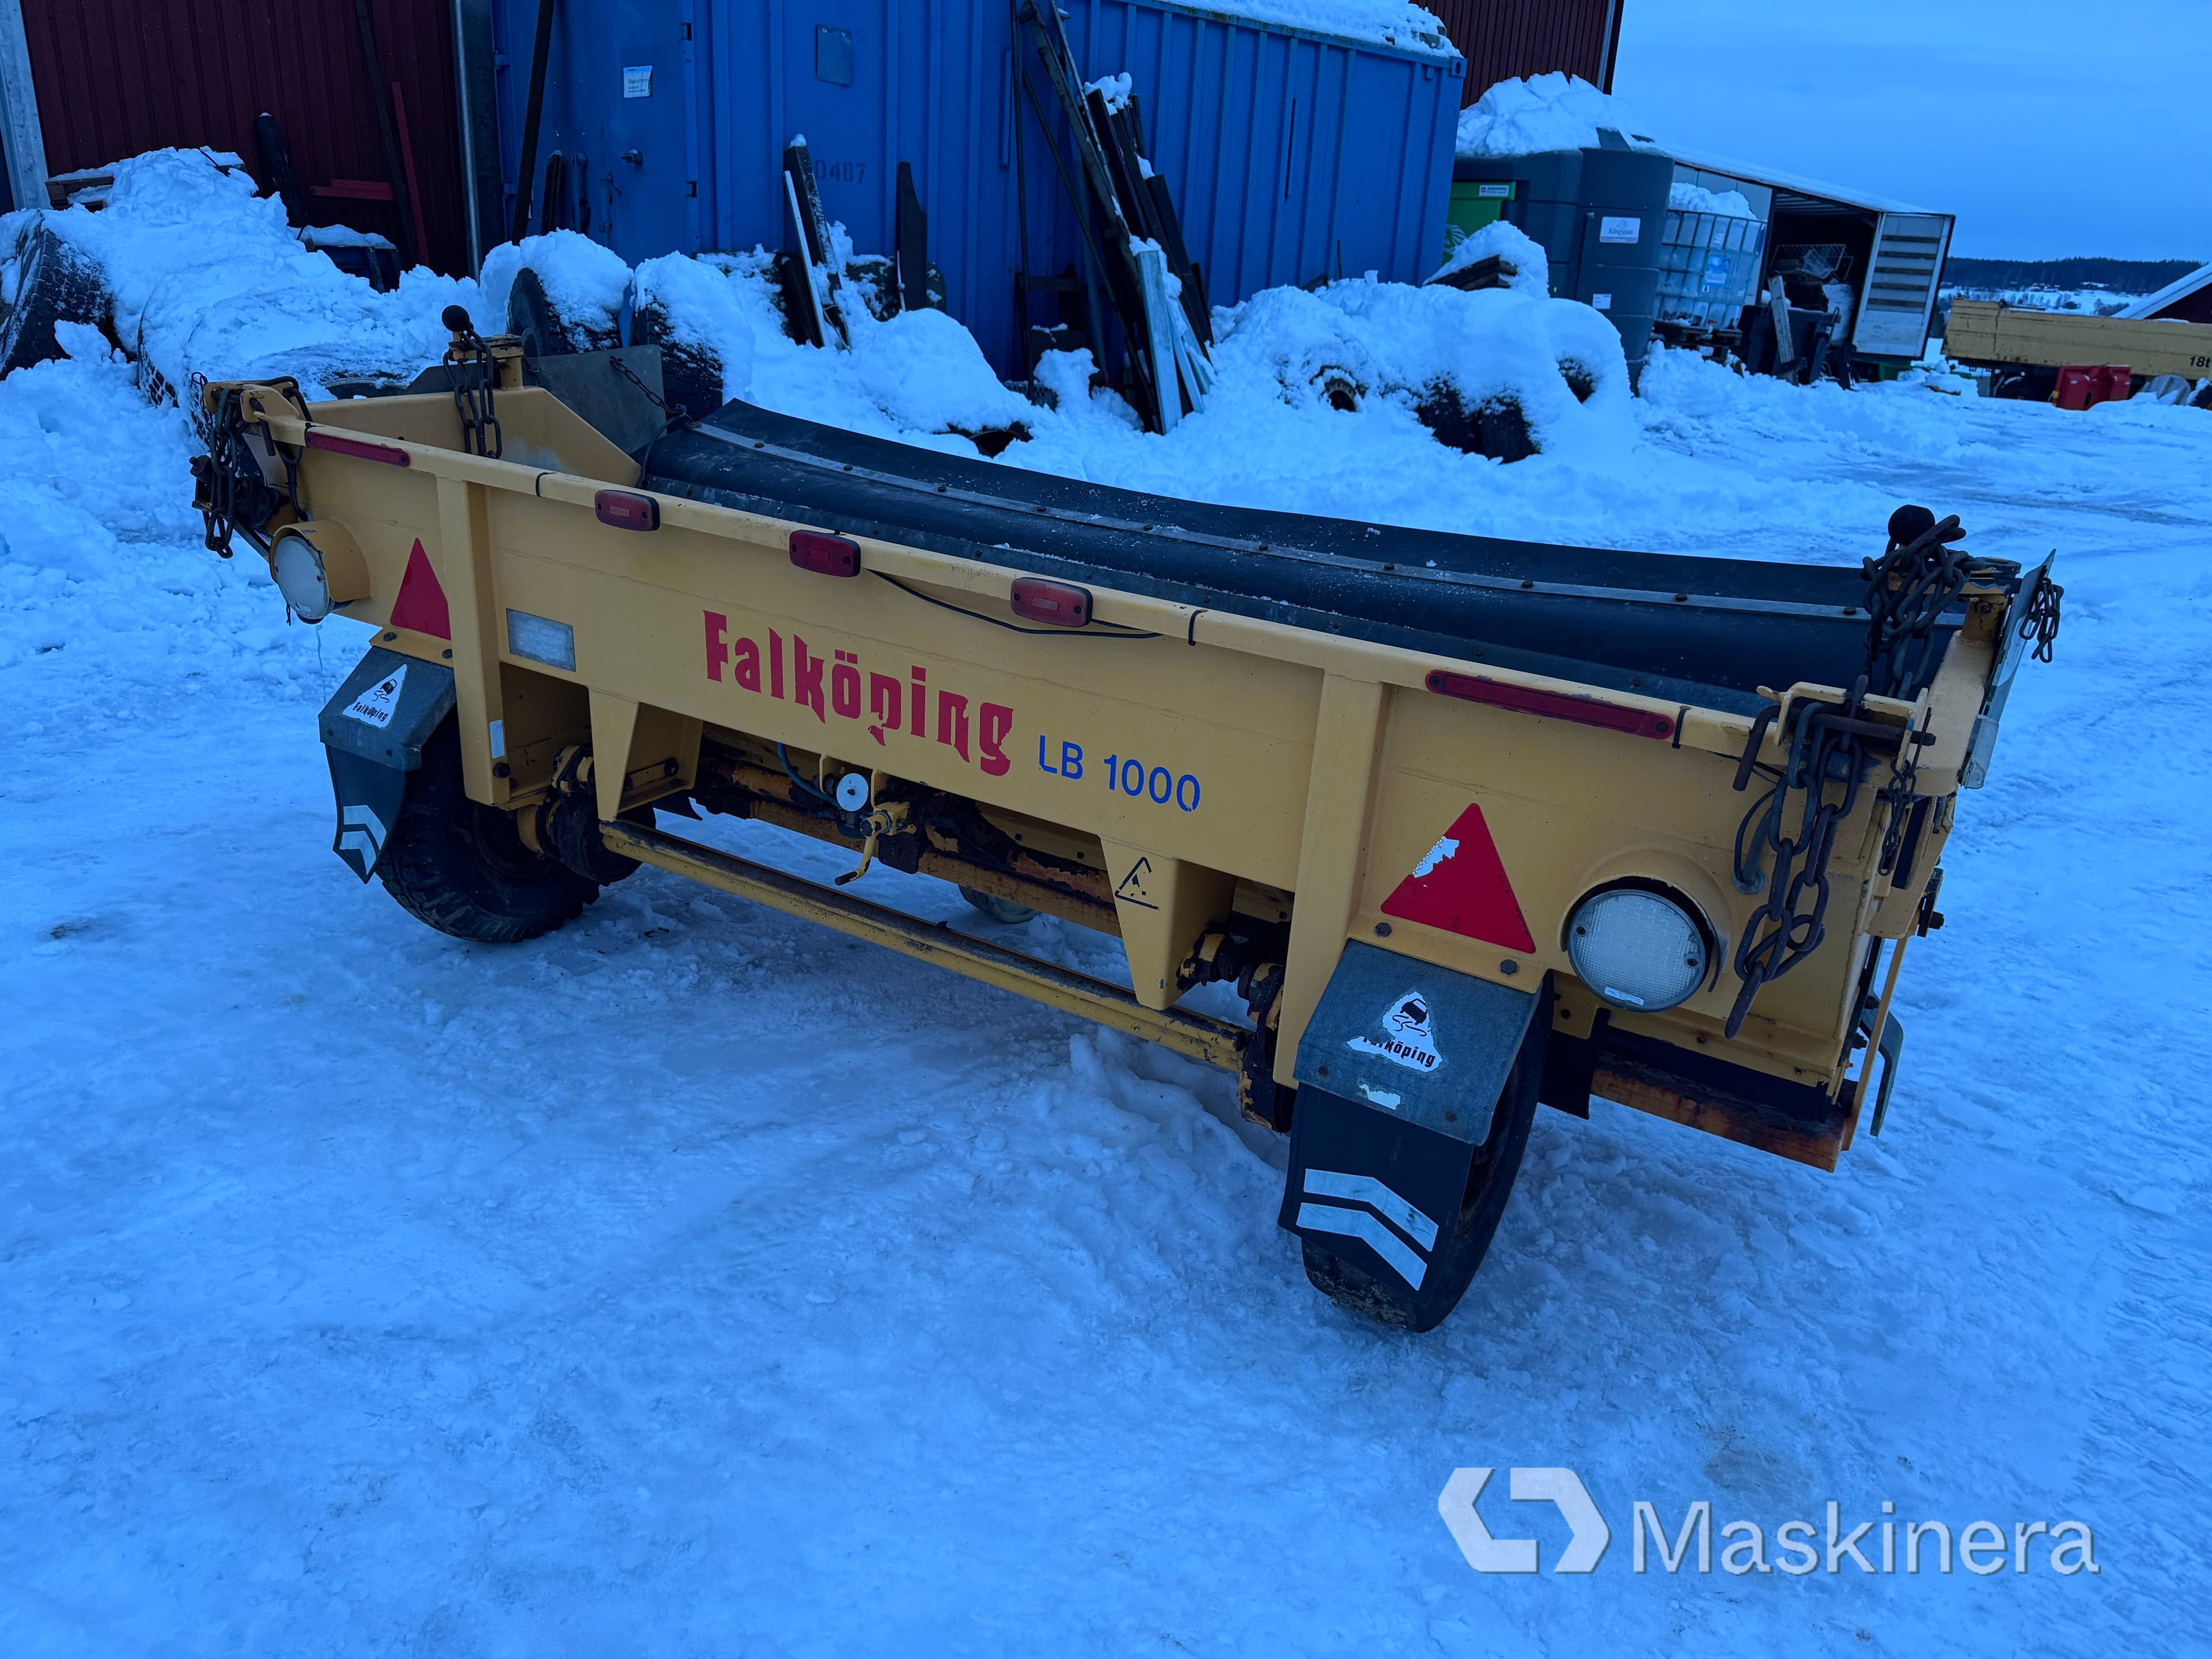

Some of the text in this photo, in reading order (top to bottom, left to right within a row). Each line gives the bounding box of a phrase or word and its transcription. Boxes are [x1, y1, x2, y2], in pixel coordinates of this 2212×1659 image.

[352, 702, 389, 722] Falköping
[703, 610, 1014, 776] Falköping
[1039, 735, 1200, 812] LB 1000
[1363, 1037, 1436, 1067] köping
